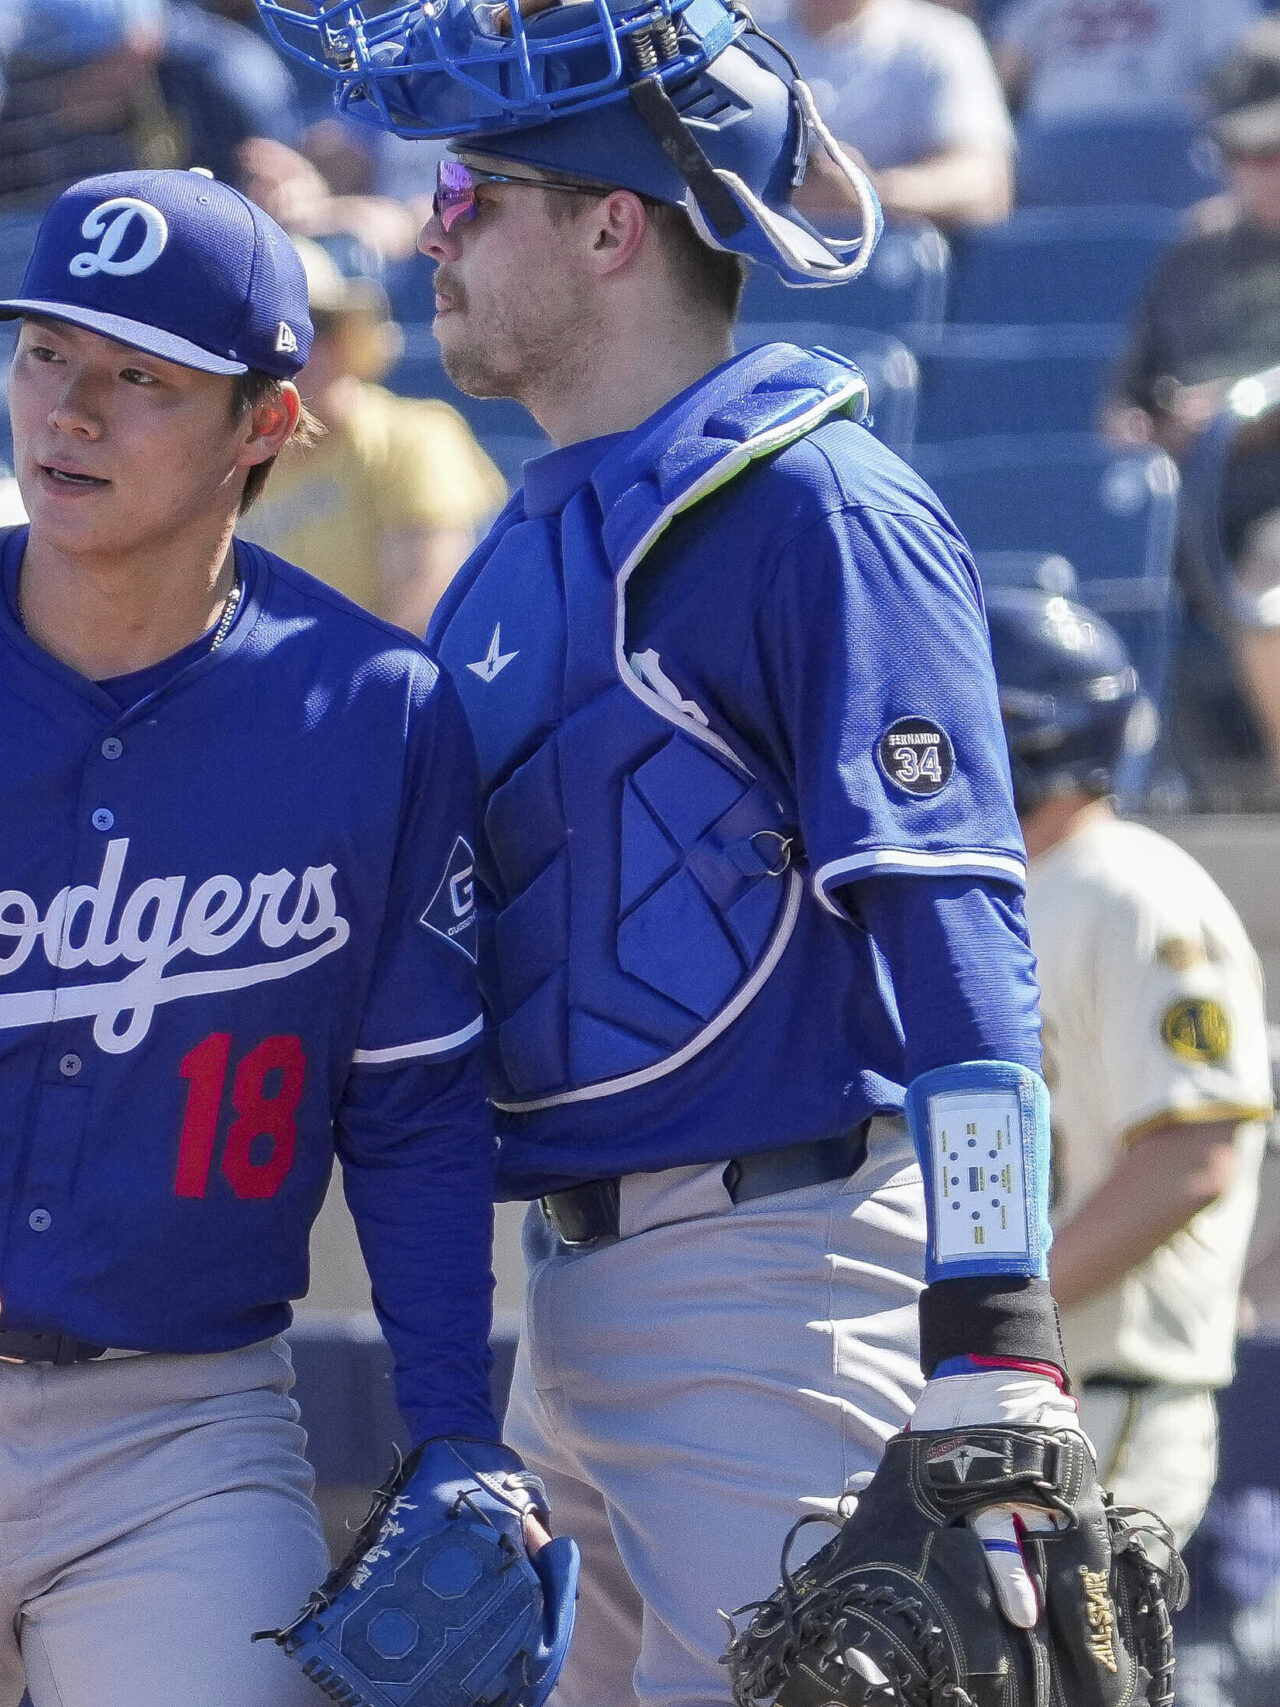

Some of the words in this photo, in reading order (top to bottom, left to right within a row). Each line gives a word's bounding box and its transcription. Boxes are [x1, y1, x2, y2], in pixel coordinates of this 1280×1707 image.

[69, 197, 168, 277] D
[888, 732, 941, 745] FERNANDO
[893, 746, 943, 782] 34
[175, 1032, 307, 1199] 18
